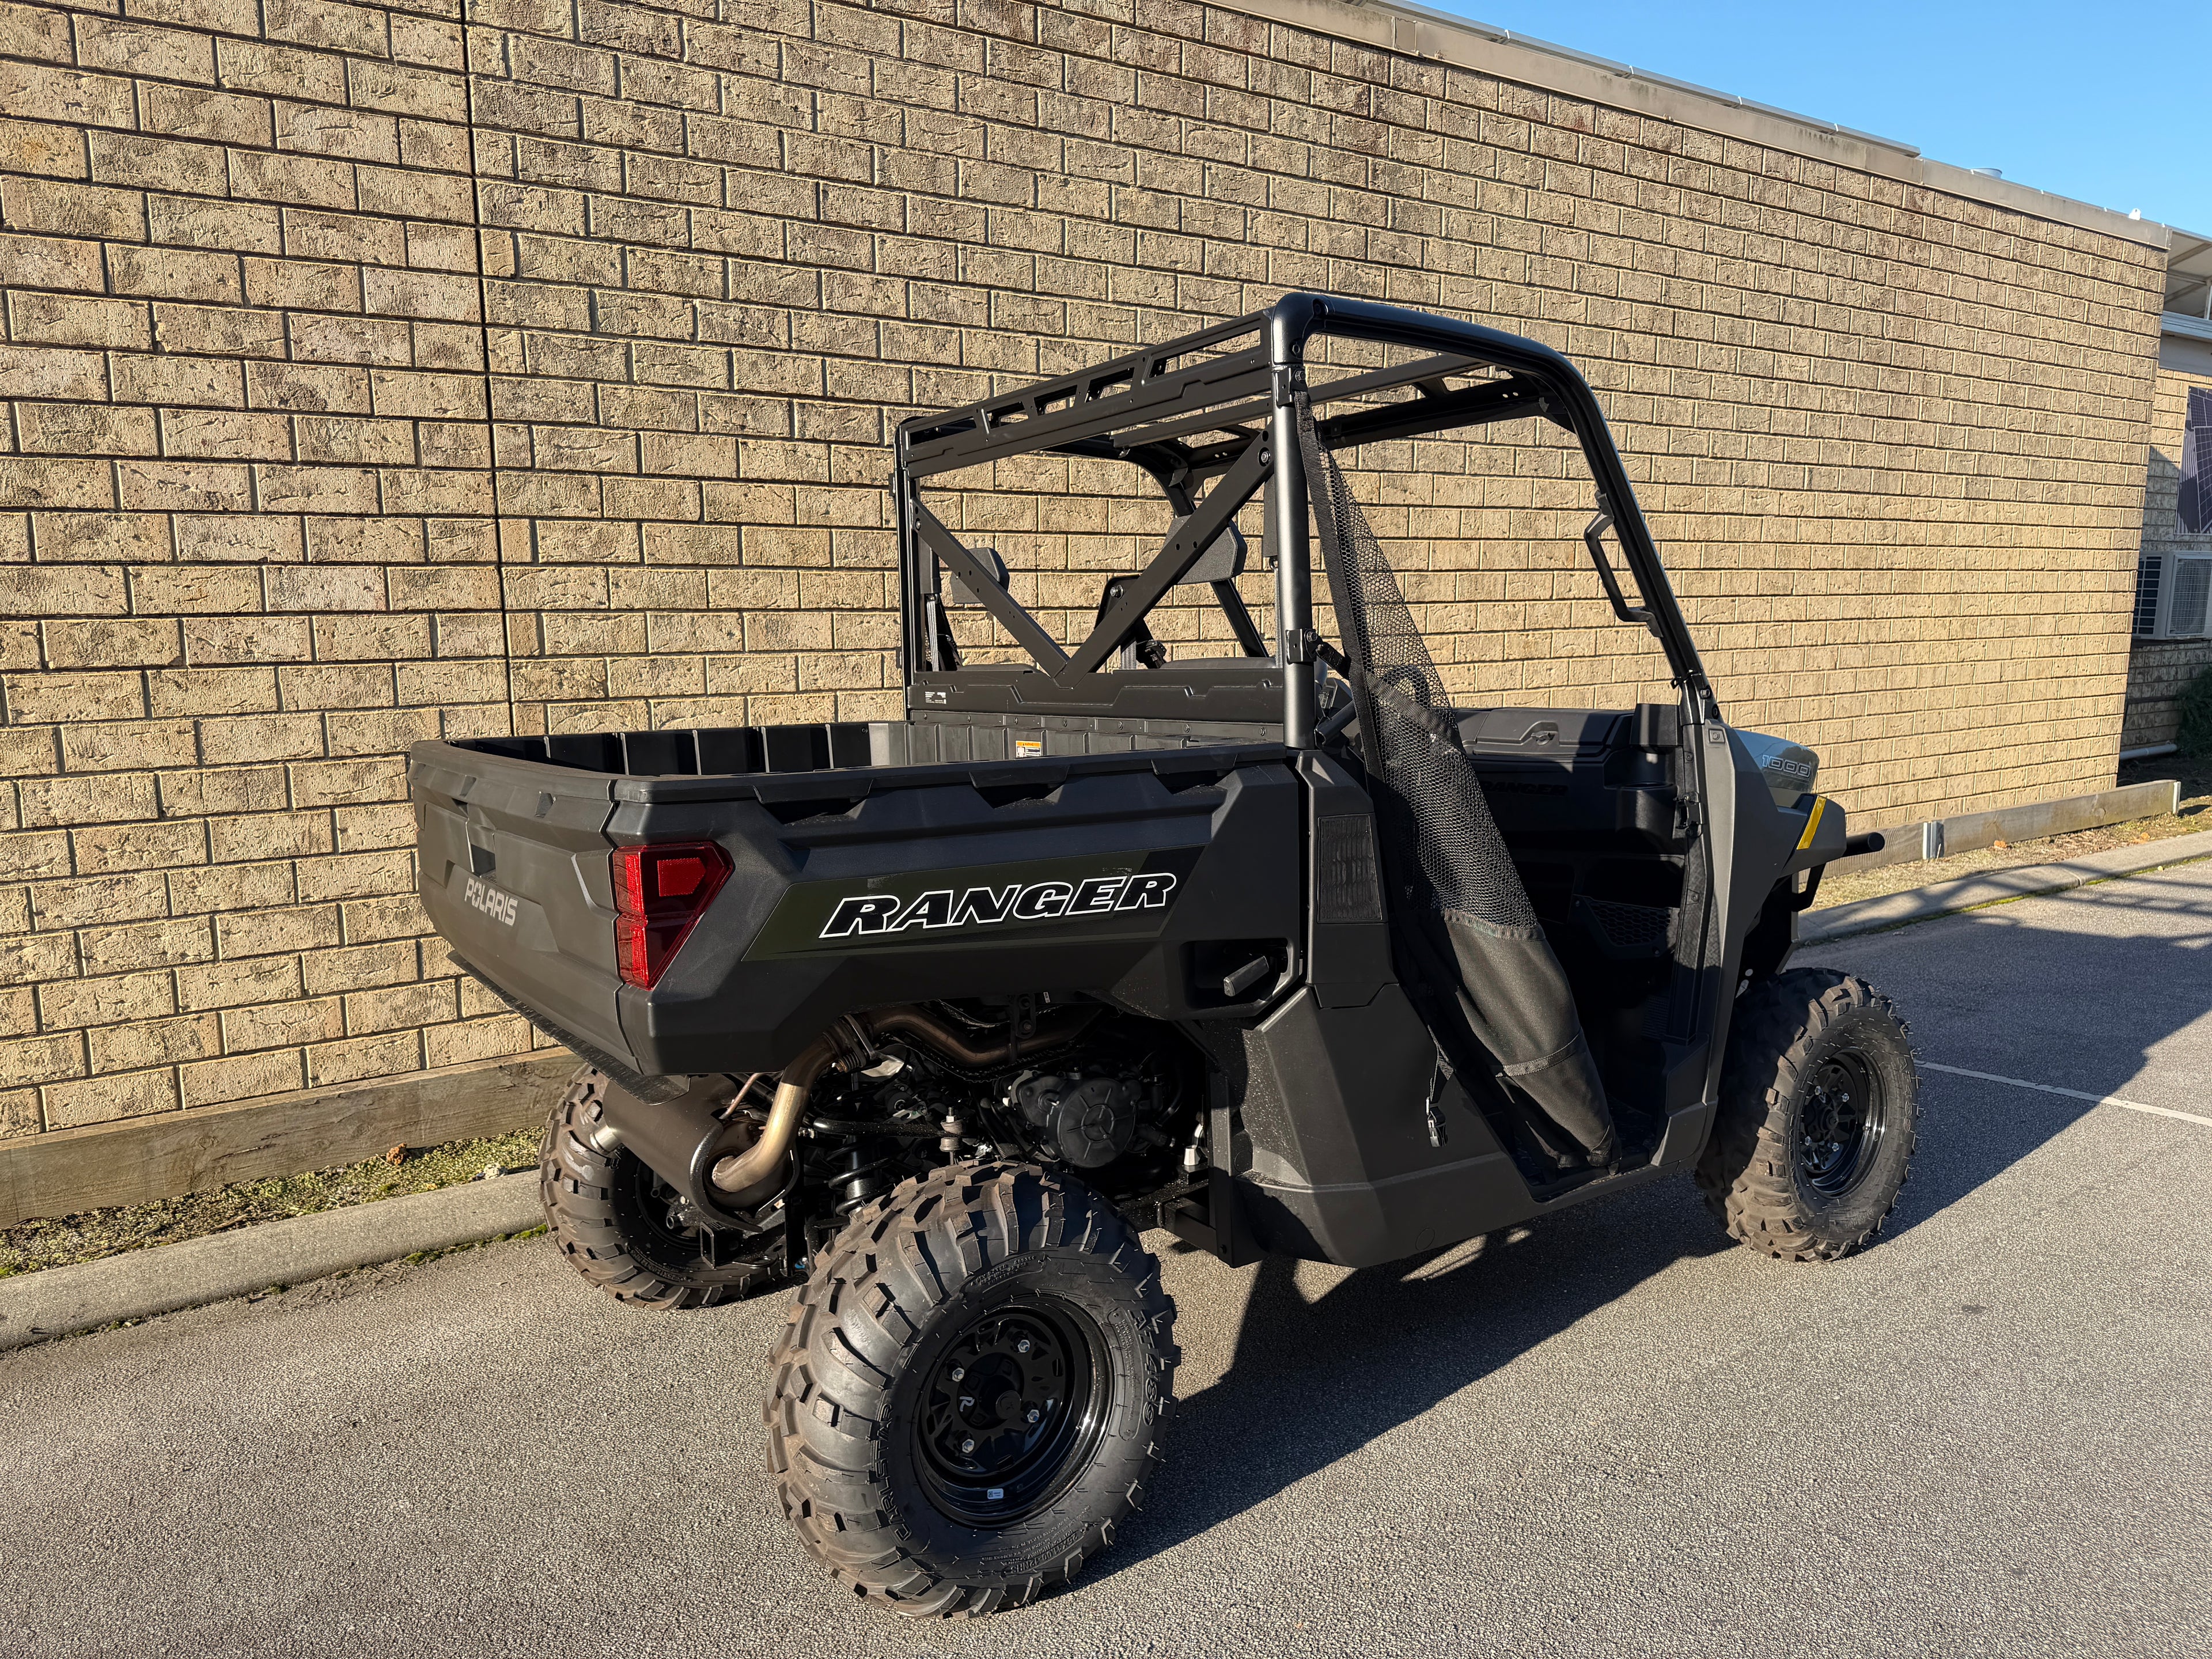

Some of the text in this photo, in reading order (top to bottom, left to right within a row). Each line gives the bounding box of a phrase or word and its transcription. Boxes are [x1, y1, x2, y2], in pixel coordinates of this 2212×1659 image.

[1762, 754, 1810, 777] 1000
[464, 877, 518, 926] POLARIS
[819, 873, 1176, 938] RANGER
[1128, 1309, 1157, 1426] AT489
[874, 1403, 912, 1541] CARLSTAR
